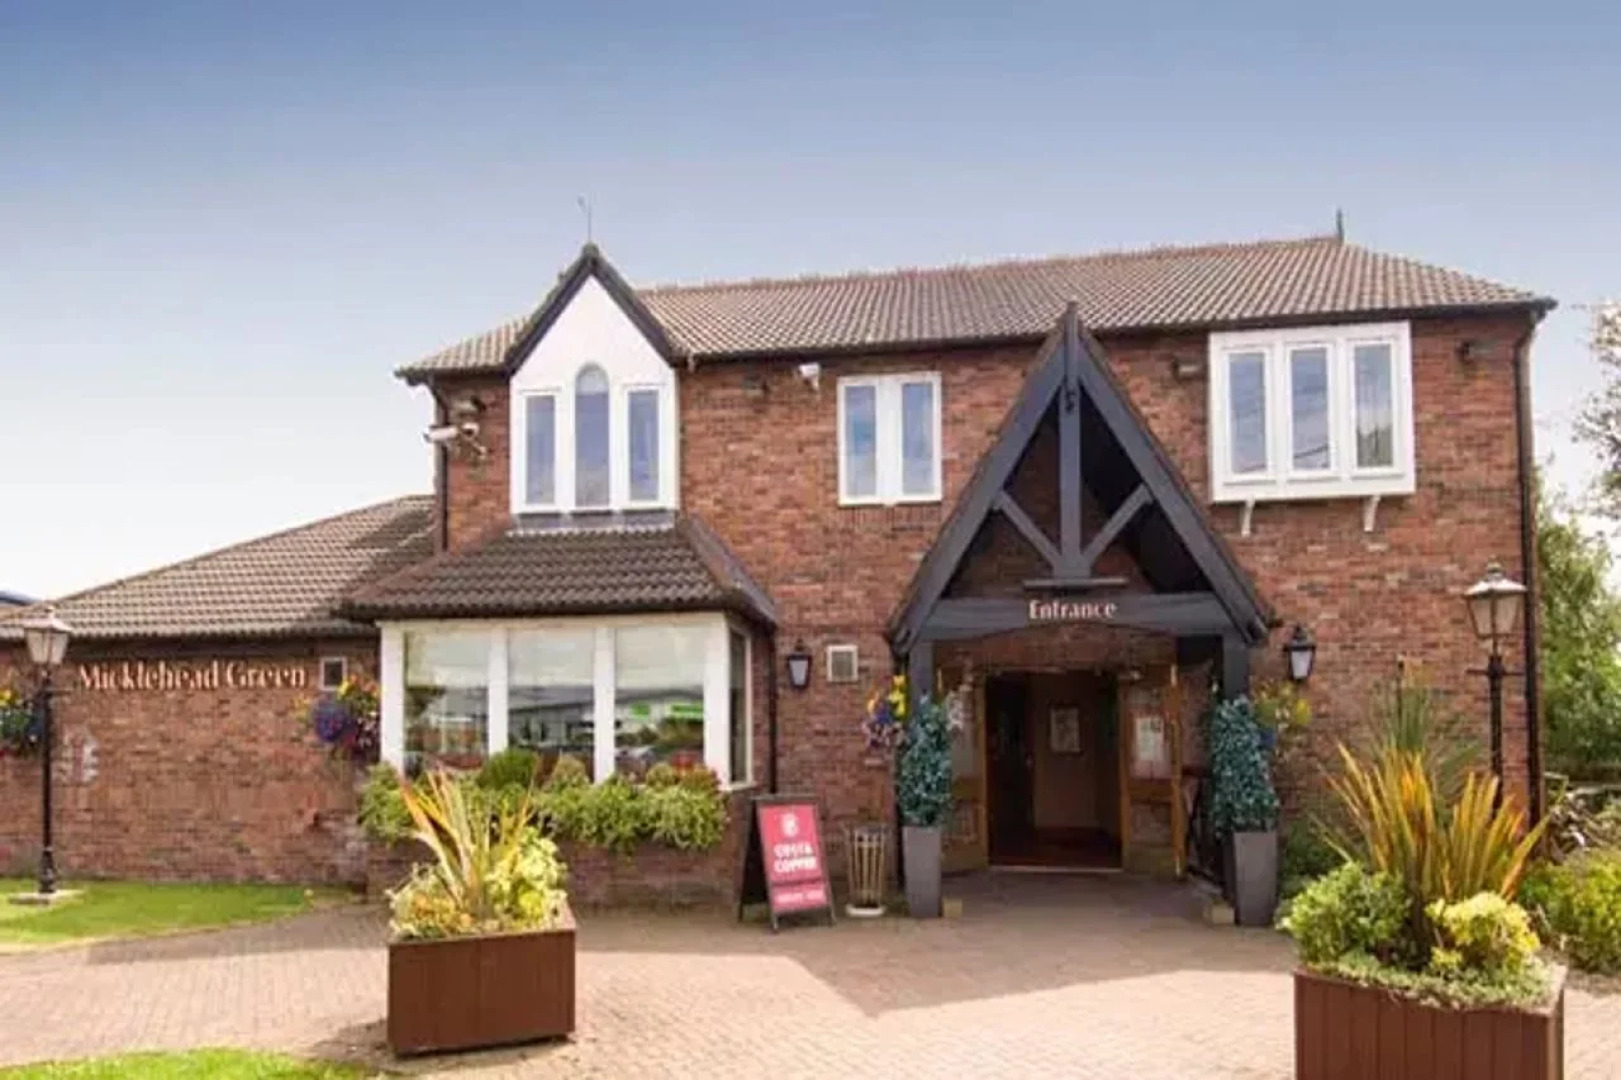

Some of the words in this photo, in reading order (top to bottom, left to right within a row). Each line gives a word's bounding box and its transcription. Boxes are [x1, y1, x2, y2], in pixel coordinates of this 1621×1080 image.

[1029, 599, 1118, 620] Entrance
[79, 659, 217, 690] Micklehead
[226, 659, 306, 688] Green
